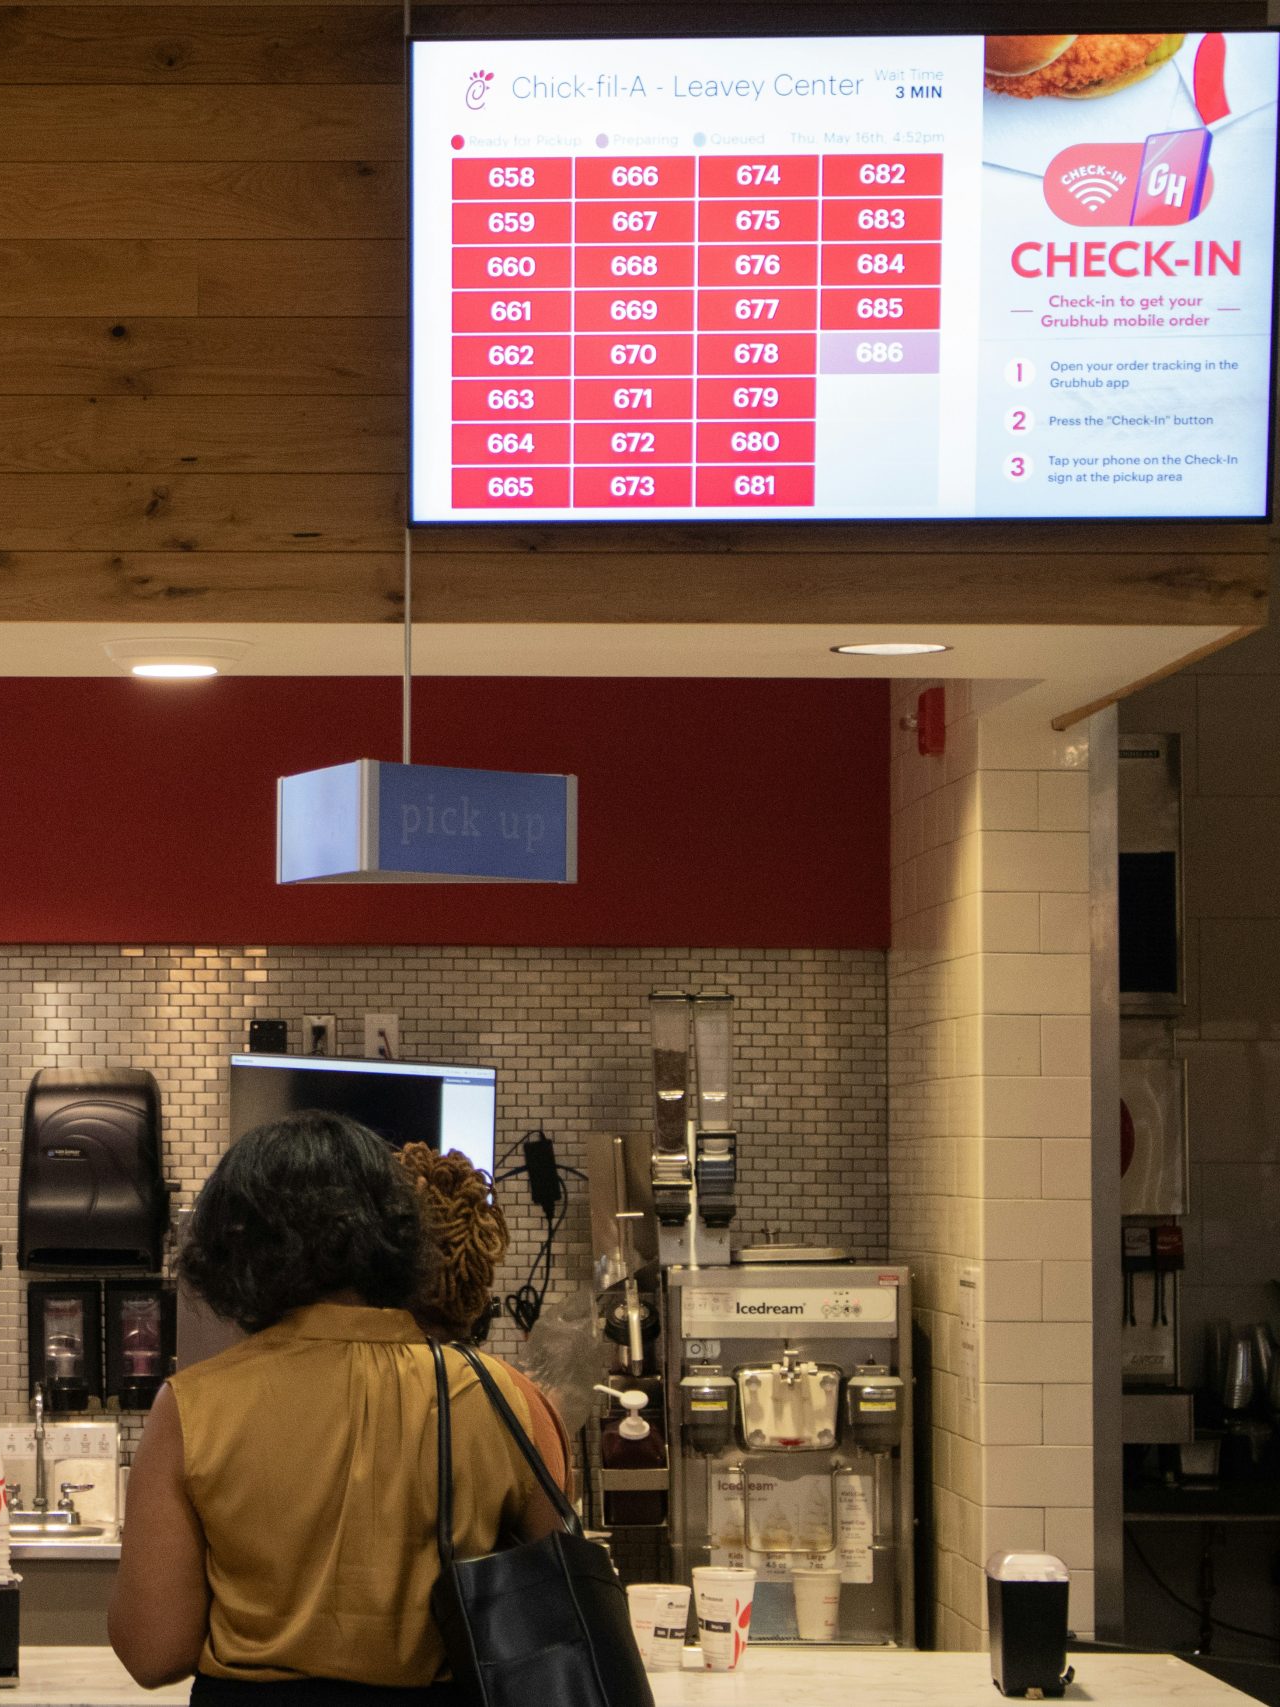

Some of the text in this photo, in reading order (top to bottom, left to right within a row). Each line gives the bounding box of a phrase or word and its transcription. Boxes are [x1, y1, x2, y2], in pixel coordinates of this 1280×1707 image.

[875, 68, 944, 82] Wait Time
[512, 73, 864, 101] Chick-fil-A Leavey Center
[896, 86, 943, 99] 3 MIN
[613, 134, 679, 150] Preparing
[709, 133, 765, 148] Queued
[824, 132, 850, 144] May
[893, 131, 944, 145] 4:52pm
[488, 167, 535, 188] 658
[611, 166, 659, 186] 666
[736, 165, 781, 185] 674
[859, 163, 905, 184] 682
[1060, 163, 1128, 188] CHECK-IN
[1147, 162, 1187, 208] GH
[488, 212, 535, 233] 659
[611, 211, 658, 232] 667
[735, 210, 780, 231] 675
[857, 208, 905, 230] 683
[487, 256, 536, 277] 660
[610, 255, 658, 276] 668
[735, 254, 780, 275] 676
[857, 253, 905, 274] 684
[1011, 240, 1241, 278] CHECK-IN
[490, 301, 531, 322] 661
[610, 300, 658, 321] 669
[735, 299, 779, 320] 677
[856, 298, 904, 319] 685
[1048, 295, 1203, 310] Check-in to get your
[1041, 314, 1210, 327] Grubhub mobile order
[488, 345, 534, 366] 662
[610, 344, 657, 365] 670
[734, 343, 779, 364] 678
[856, 342, 903, 363] 686
[1017, 363, 1022, 382] 1
[1050, 360, 1239, 373] Open your order tracking in the
[1050, 377, 1130, 389] Grubhub app
[487, 389, 534, 410] 663
[613, 388, 652, 409] 671
[733, 387, 779, 408] 679
[1013, 411, 1026, 430] 2
[1049, 415, 1214, 426] Press the "Check-In" button
[487, 433, 535, 454] 664
[611, 432, 655, 453] 672
[731, 431, 780, 452] 680
[1011, 457, 1025, 477] 3
[1048, 454, 1238, 467] Tap your phone on the Check-In
[488, 477, 534, 498] 665
[610, 476, 655, 496] 673
[734, 475, 774, 496] 681
[1048, 471, 1184, 485] sign at the pickup area
[401, 794, 546, 853] pick up
